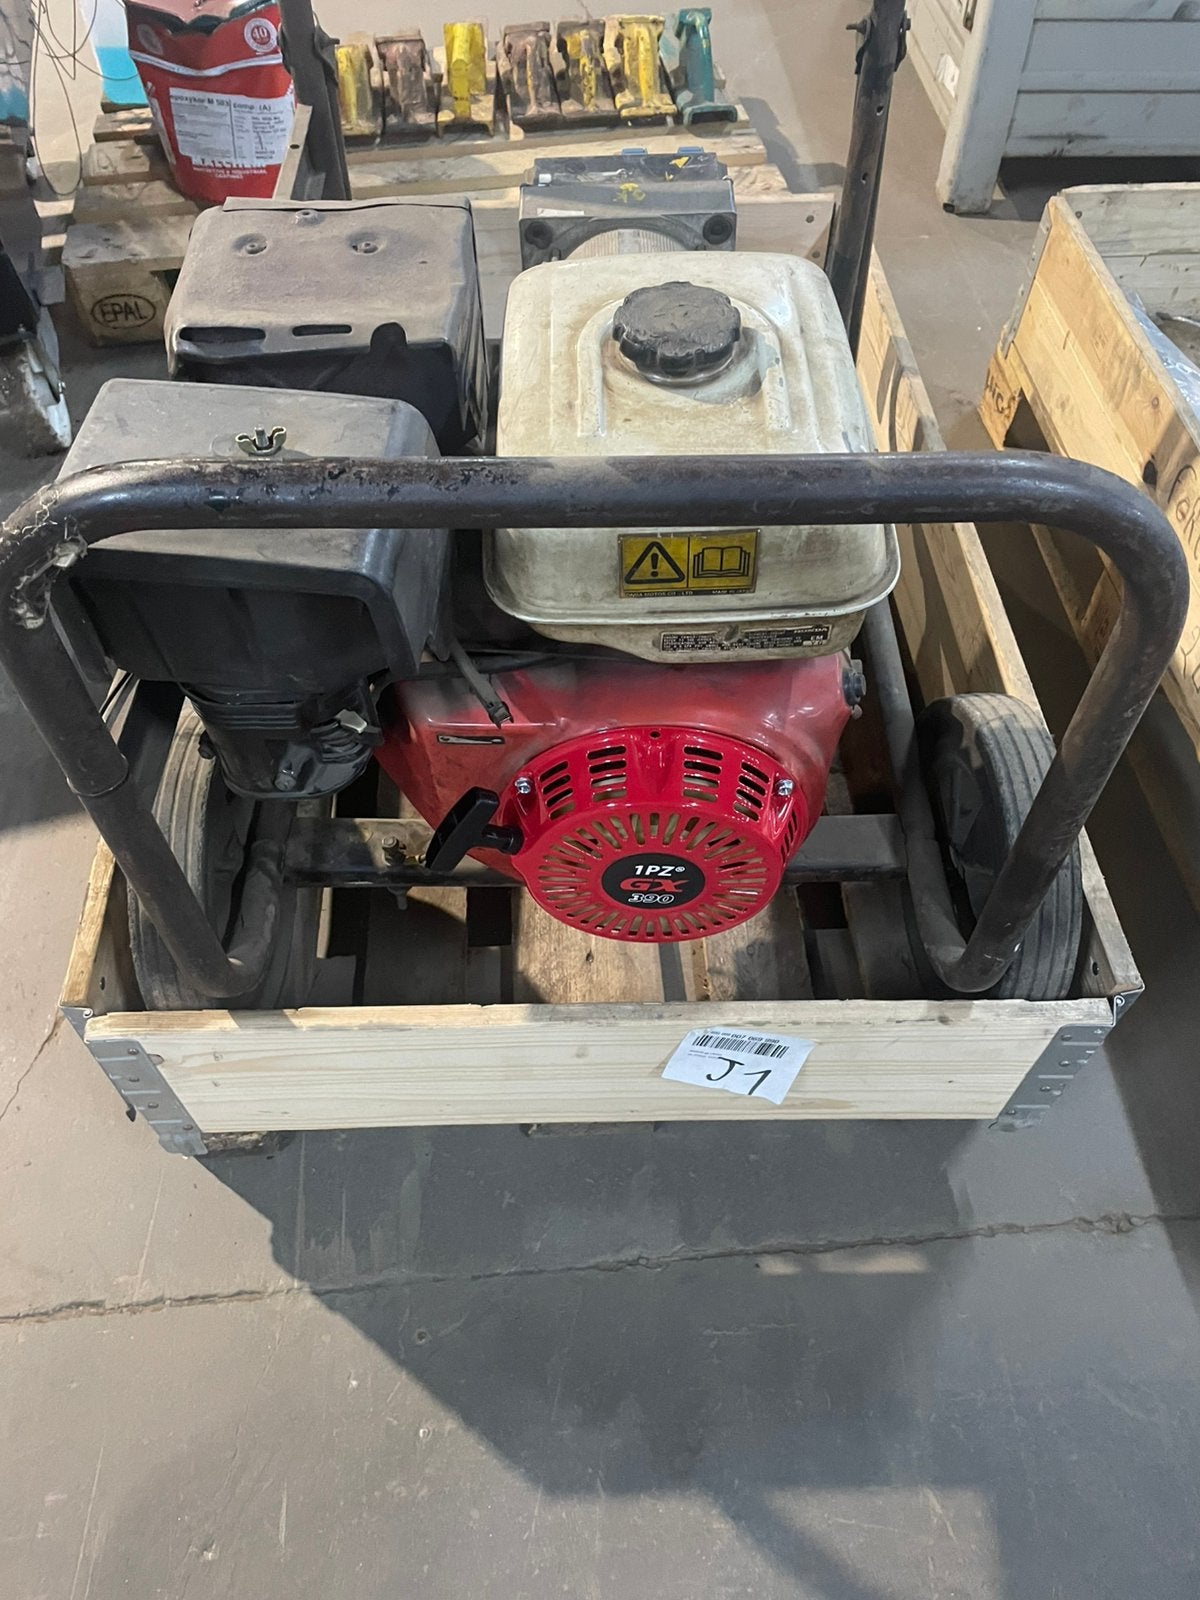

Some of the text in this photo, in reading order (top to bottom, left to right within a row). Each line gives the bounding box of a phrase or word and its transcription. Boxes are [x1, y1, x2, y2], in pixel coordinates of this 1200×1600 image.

[99, 301, 147, 323] EPAL
[620, 877, 690, 893] GX
[628, 893, 675, 905] 390
